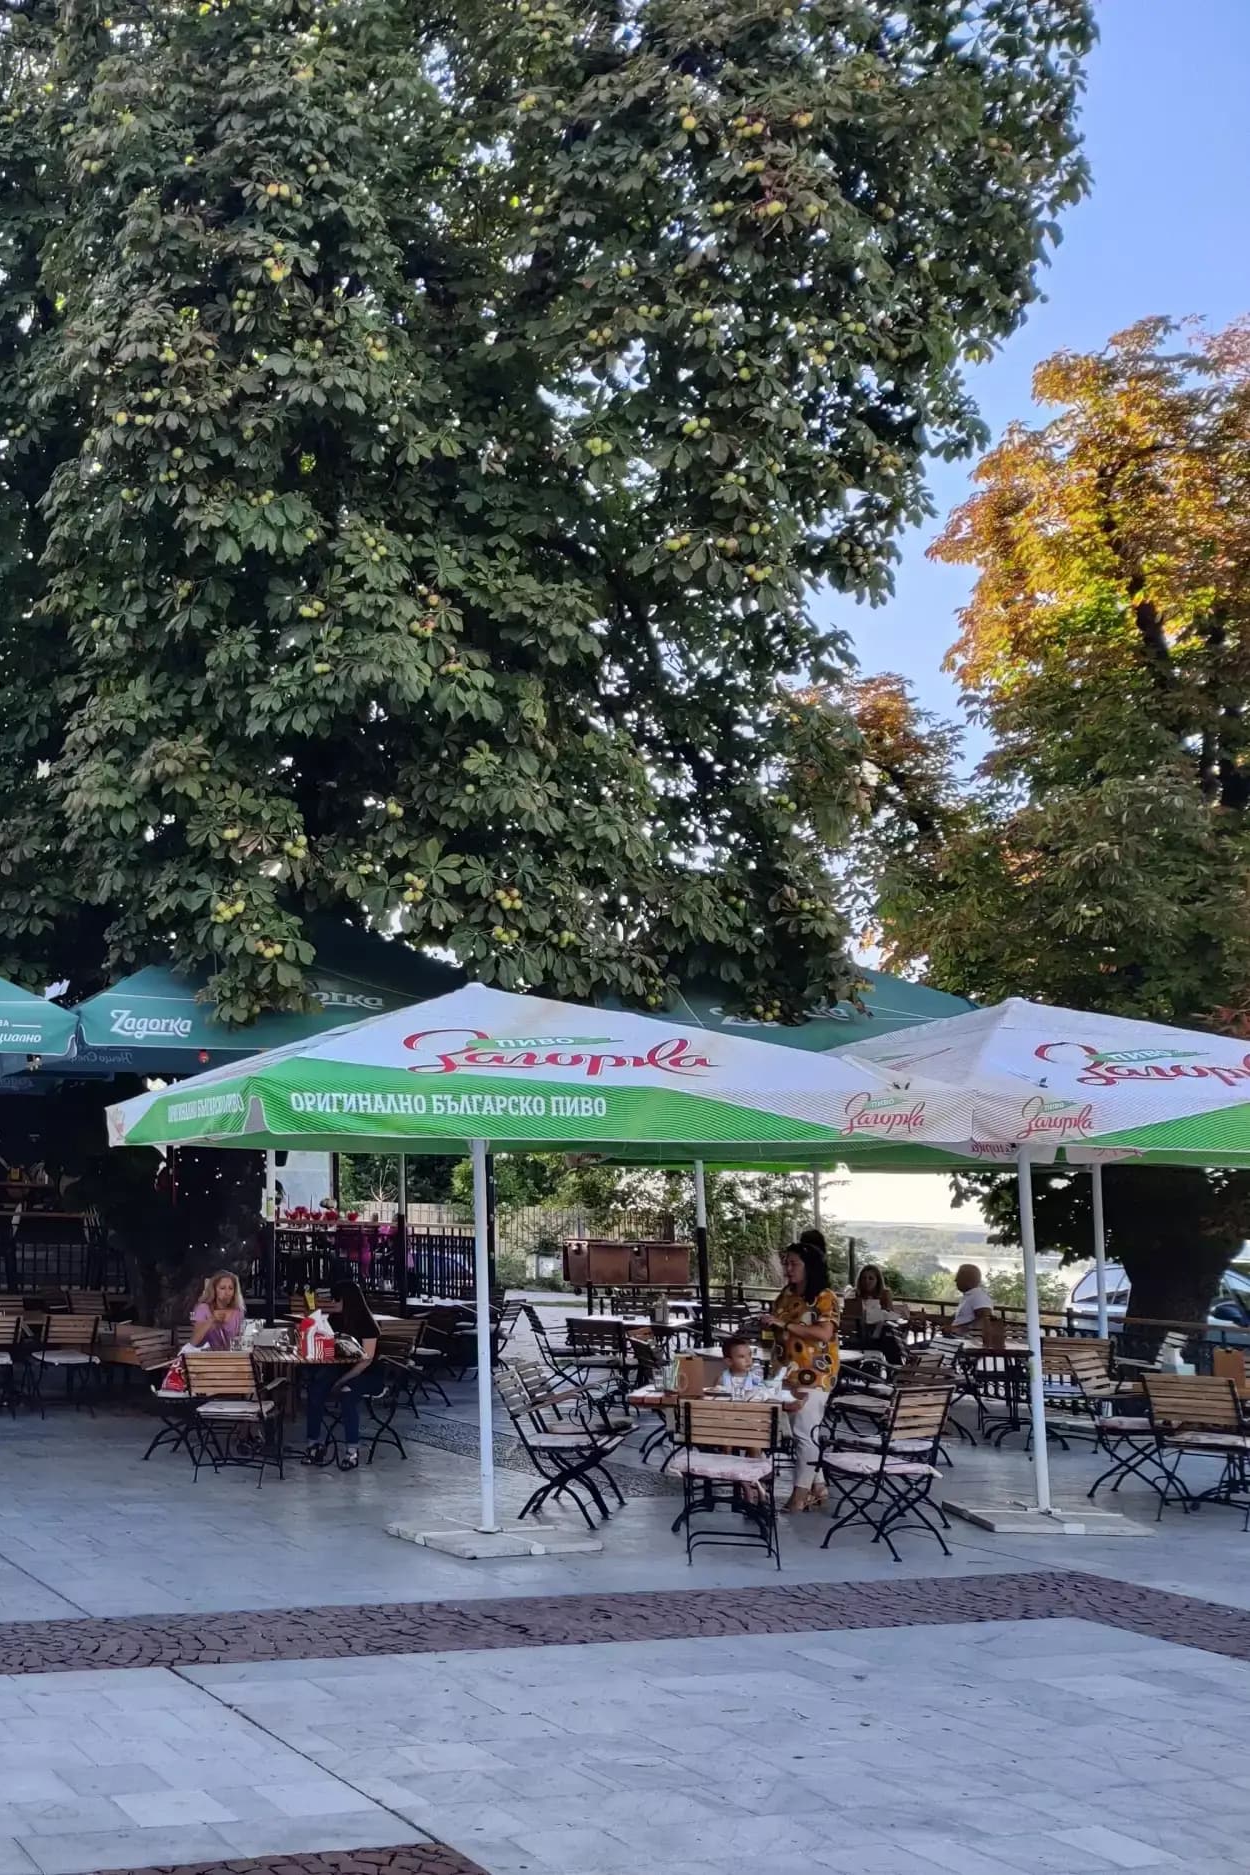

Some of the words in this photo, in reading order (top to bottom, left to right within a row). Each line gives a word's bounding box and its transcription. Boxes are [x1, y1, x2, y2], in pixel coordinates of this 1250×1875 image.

[110, 1009, 192, 1038] Zagorka
[494, 1036, 576, 1048] ПИВО
[1034, 1042, 1250, 1086] Загор
[291, 1092, 427, 1115] ОРИГИНАЛНО
[432, 1093, 547, 1116] БЪЛГАРСКО
[550, 1096, 608, 1117] ПИВО
